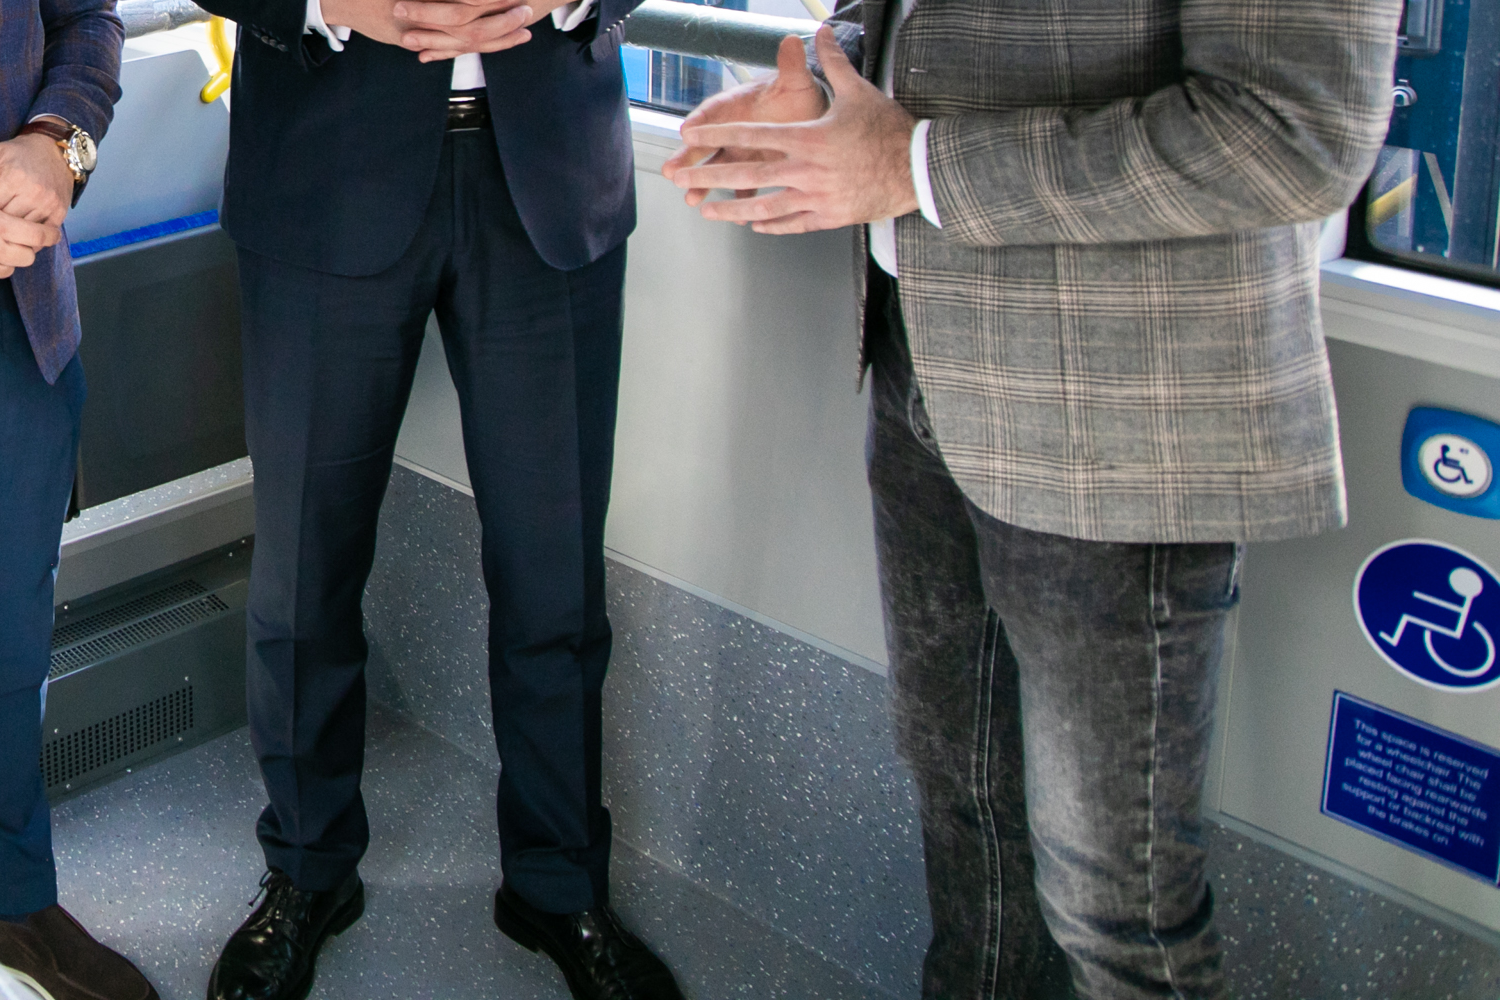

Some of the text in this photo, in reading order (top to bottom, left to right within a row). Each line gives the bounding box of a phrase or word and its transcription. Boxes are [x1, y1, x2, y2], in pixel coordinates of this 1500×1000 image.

[1354, 719, 1489, 780] This space is reserved
[1356, 733, 1373, 747] for
[1374, 742, 1383, 752] a
[1458, 771, 1482, 791] The
[1357, 749, 1477, 802] wheel chair shall be
[1342, 782, 1485, 847] support or backrest with
[1344, 757, 1488, 821] placed facing rearwards
[1359, 776, 1469, 827] resting against the
[1367, 804, 1449, 846] the brakes on
